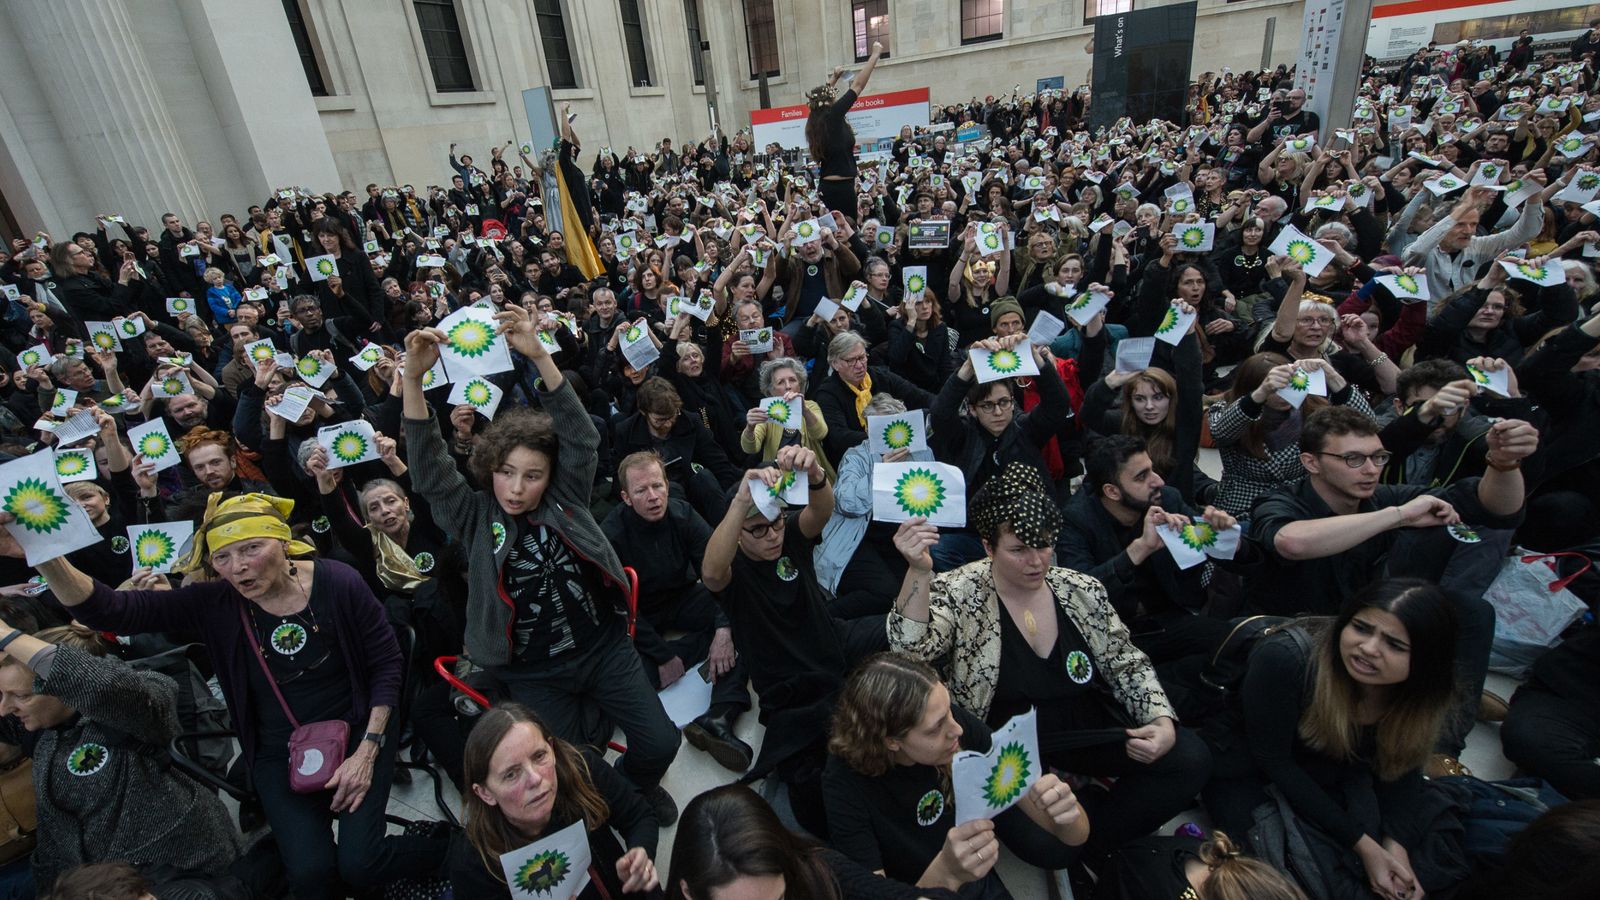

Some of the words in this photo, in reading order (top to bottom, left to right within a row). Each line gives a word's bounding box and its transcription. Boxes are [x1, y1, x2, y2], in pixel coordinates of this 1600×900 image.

[1117, 16, 1124, 28] on
[1113, 29, 1124, 58] What's
[865, 98, 885, 107] books
